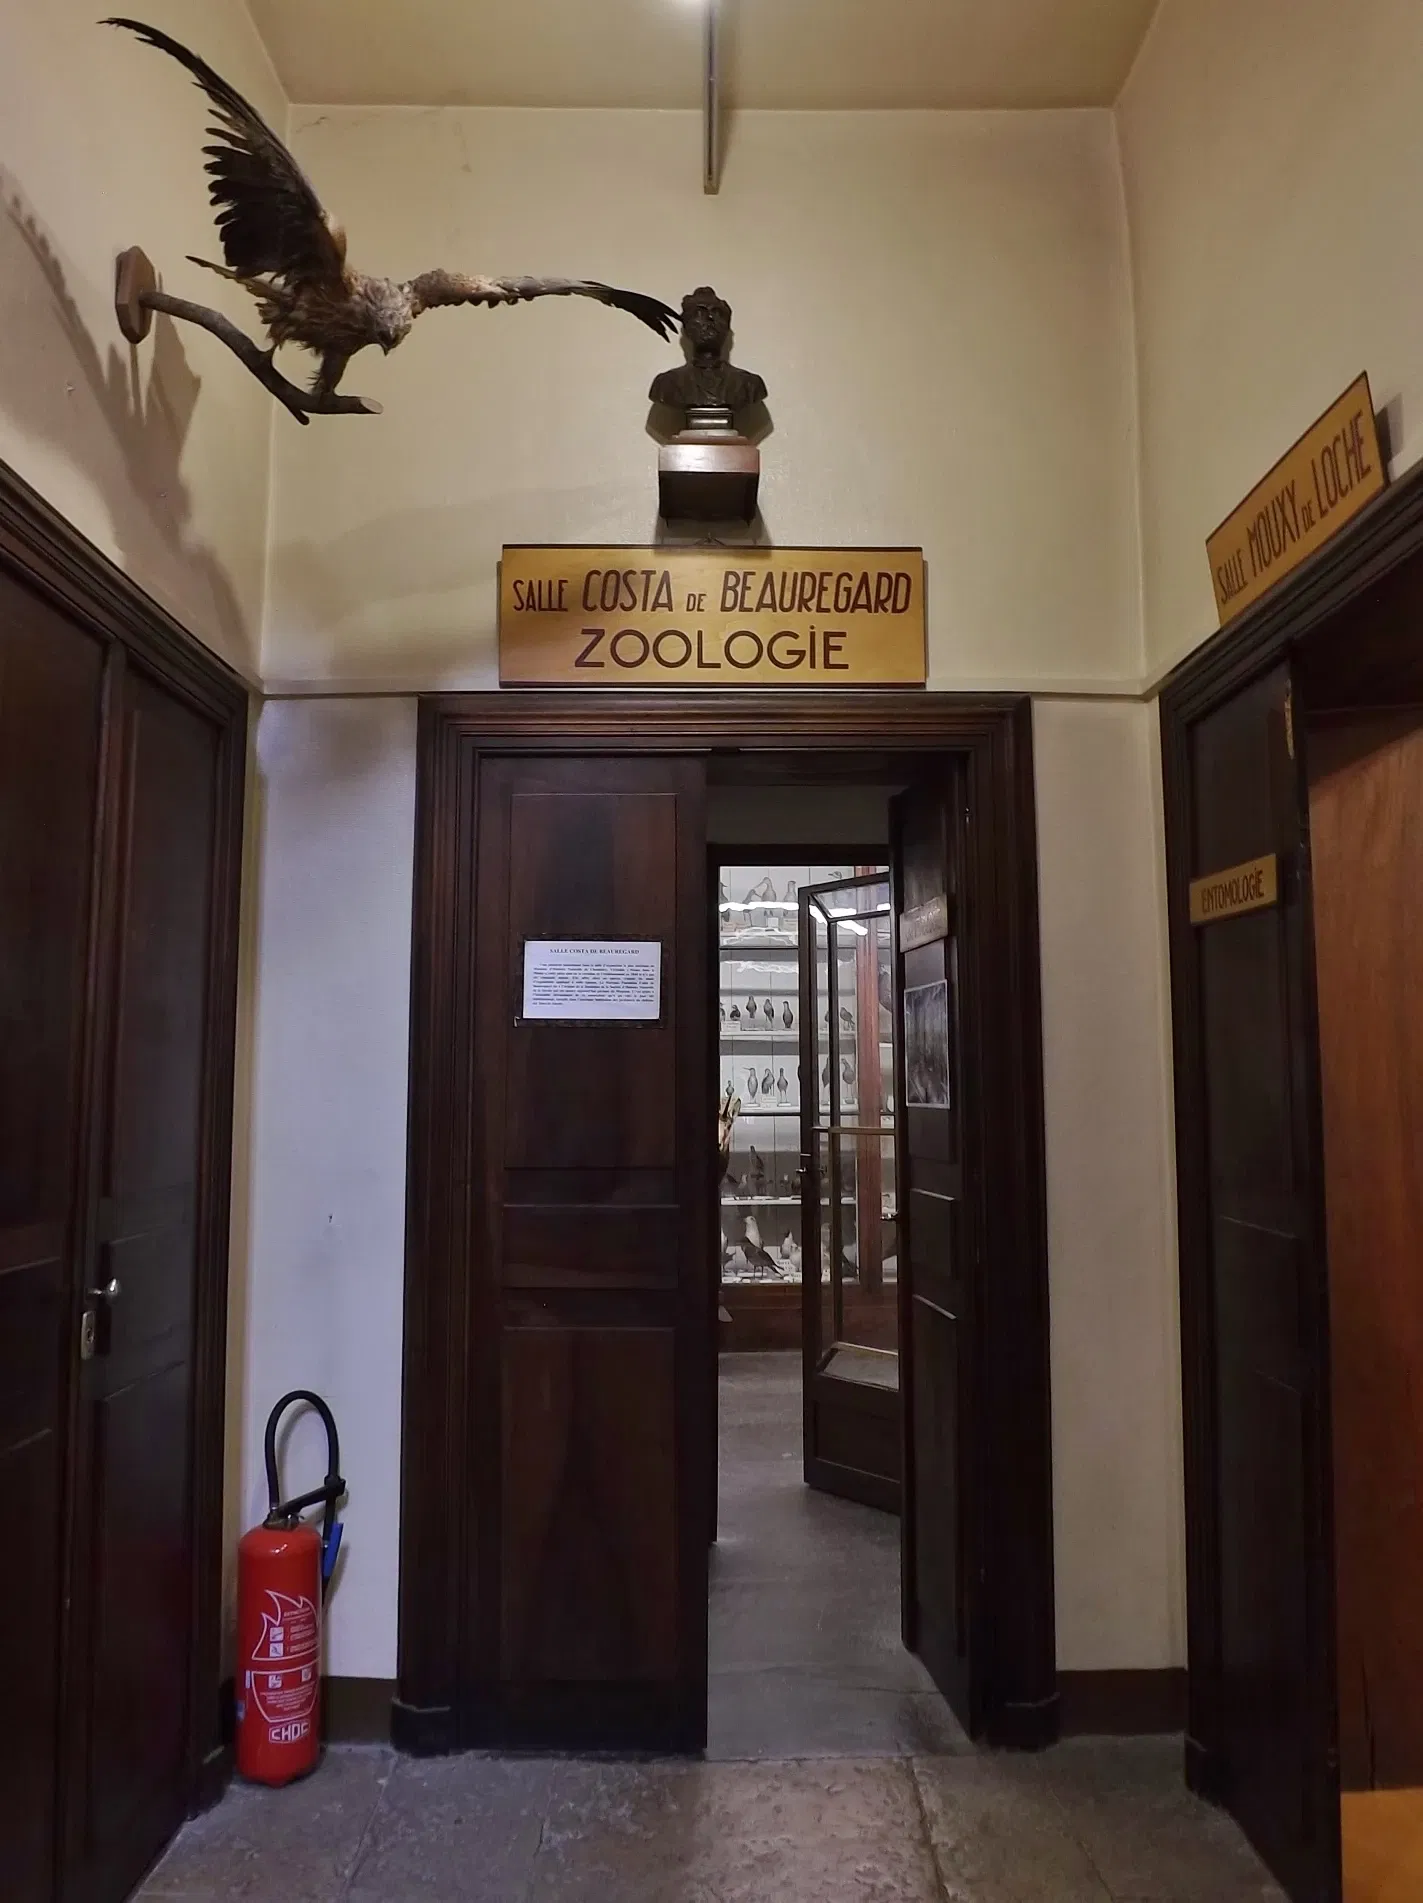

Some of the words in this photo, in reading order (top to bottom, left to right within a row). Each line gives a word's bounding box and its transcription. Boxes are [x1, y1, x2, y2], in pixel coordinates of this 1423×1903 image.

[1217, 547, 1248, 605] SALLE
[1246, 479, 1300, 578] MOUXY
[1301, 502, 1317, 533] DE
[1311, 409, 1371, 518] LOCHE
[513, 580, 568, 612] SALLE
[582, 569, 673, 612] COSTA
[686, 593, 707, 612] DE
[720, 571, 912, 614] BEAUREGARD
